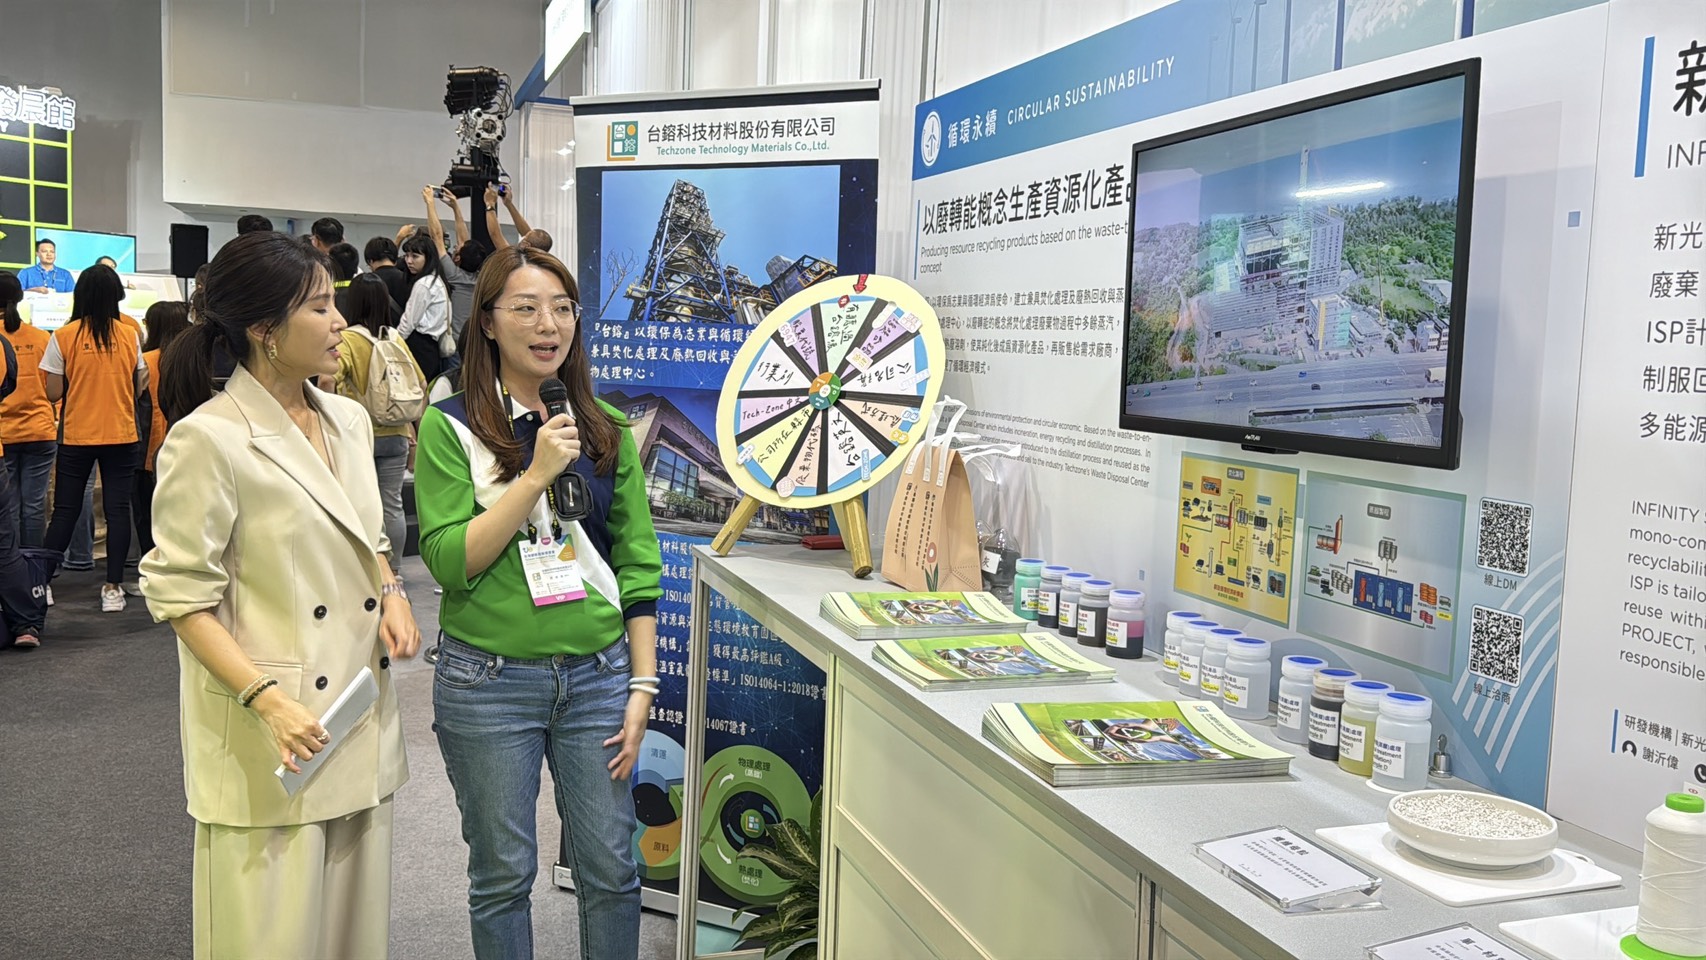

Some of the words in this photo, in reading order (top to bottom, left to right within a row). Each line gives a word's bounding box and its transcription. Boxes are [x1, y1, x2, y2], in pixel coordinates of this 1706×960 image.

[1007, 94, 1060, 126] CIRCULAR
[1064, 56, 1175, 107] SUSTAINABILITY
[647, 117, 836, 143] 台鎔科技材料股份有限公司
[948, 108, 998, 149] 循環永續
[657, 145, 696, 156] Techzone
[699, 143, 749, 156] Technology
[751, 142, 792, 153] Materials
[795, 140, 829, 153] Co.,Ltd.
[921, 243, 949, 258] Producing
[950, 242, 975, 254] resource
[976, 236, 1006, 253] recycling
[1006, 233, 1038, 250] products
[1040, 230, 1063, 244] based
[1065, 229, 1075, 240] on
[1078, 226, 1092, 239] the
[1653, 221, 1703, 251] 新光
[920, 262, 942, 274] concept
[1649, 270, 1699, 299] 廢棄
[757, 361, 794, 385] 行業別
[743, 403, 784, 420] Tech-Zone
[1012, 415, 1033, 424] protection
[1042, 419, 1058, 429] circular
[1059, 422, 1081, 432] economic.
[1084, 424, 1099, 434] Based
[1107, 428, 1116, 437] the
[1640, 411, 1706, 443] 多能源
[986, 423, 997, 431] which
[998, 425, 1013, 434] includes
[1039, 432, 1054, 442] energy
[1055, 435, 1076, 446] recycling
[1077, 438, 1086, 446] and
[1087, 440, 1112, 451] distillation
[1114, 445, 1142, 456] processes.
[1145, 448, 1151, 458] In
[1058, 448, 1081, 459] distillation
[1083, 453, 1101, 462] process
[1103, 457, 1112, 466] and
[1114, 459, 1131, 469] reused
[1140, 463, 1150, 473] the
[1091, 468, 1106, 479] Waste
[1107, 471, 1129, 484] Disposal
[1130, 476, 1149, 488] Center
[1632, 500, 1700, 523] INFINITY
[1484, 574, 1517, 591] 線上DM
[1630, 574, 1653, 591] ISP
[1657, 579, 1669, 595] is
[1673, 583, 1706, 603] tailo
[1624, 601, 1663, 619] reuse
[1622, 622, 1695, 655] PROJECT,
[1619, 649, 1706, 681] responsible
[1625, 714, 1672, 741] 研發機構
[738, 757, 771, 771] 物理處理
[1642, 746, 1679, 770] 謝沂偉
